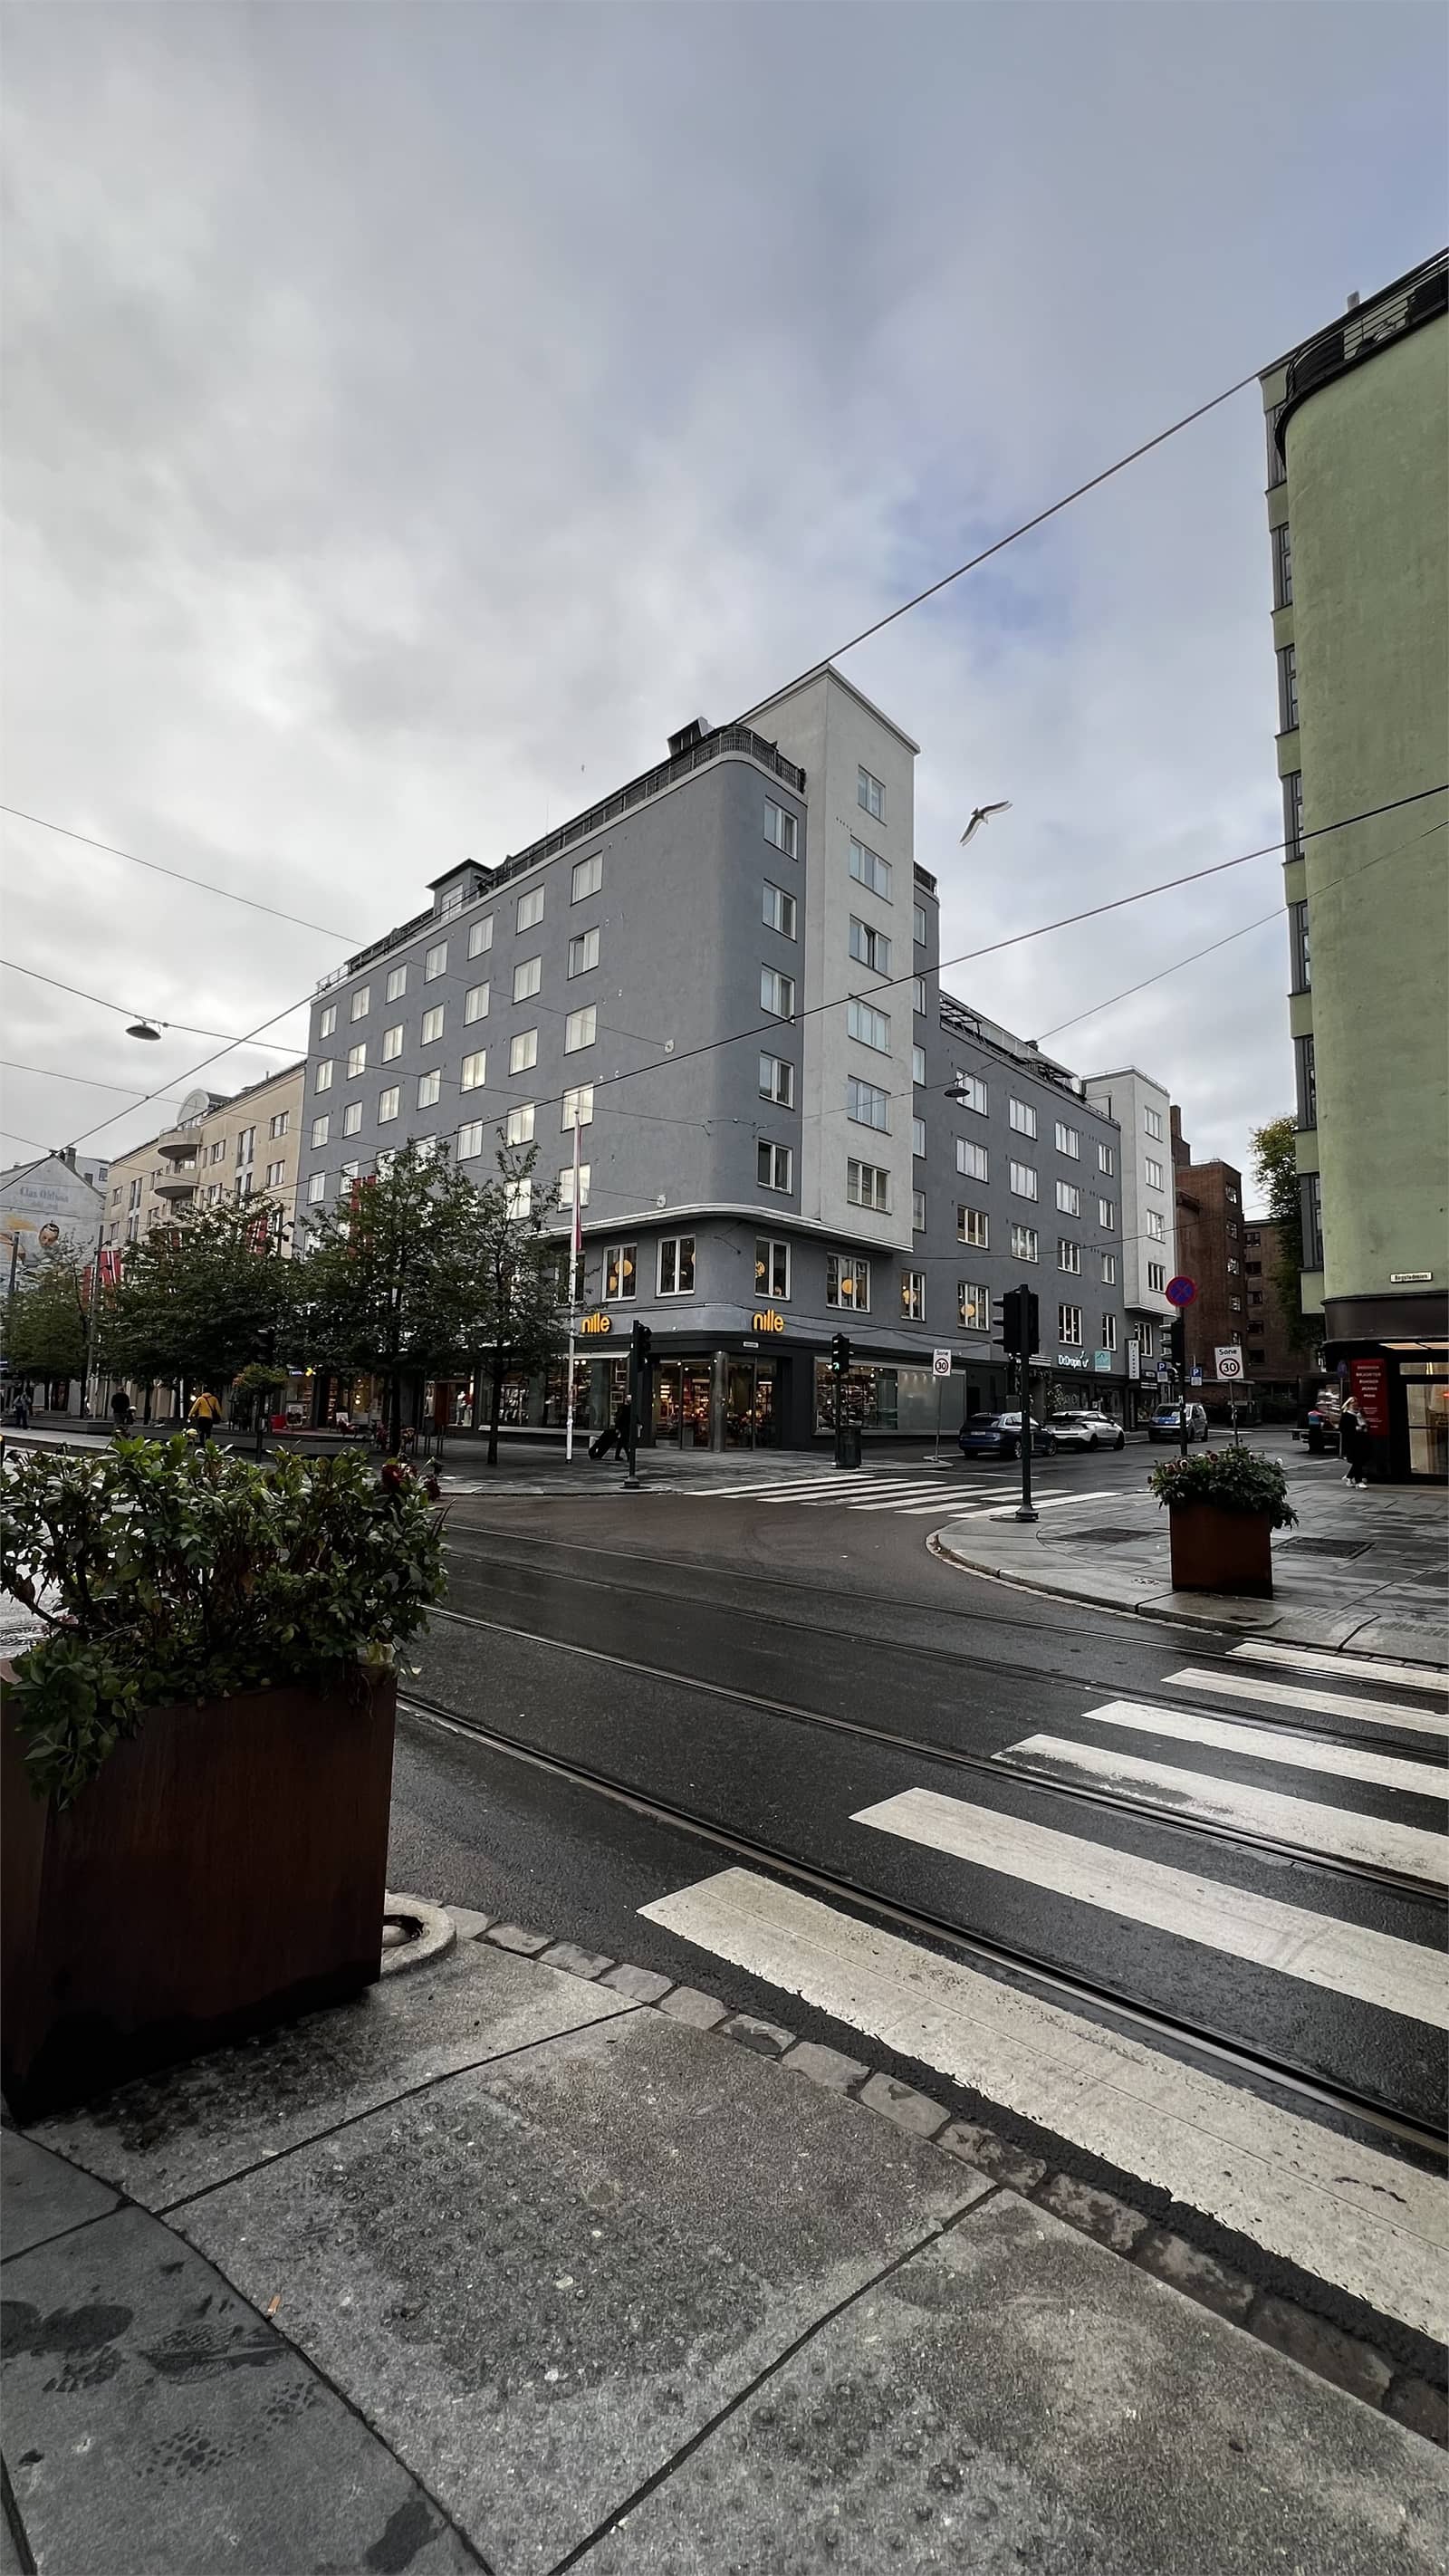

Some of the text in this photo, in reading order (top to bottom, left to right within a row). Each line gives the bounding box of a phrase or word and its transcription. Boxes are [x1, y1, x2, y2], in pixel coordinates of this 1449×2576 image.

[581, 1312, 610, 1333] nille
[753, 1309, 784, 1332] nille
[1158, 1362, 1166, 1371] P
[1223, 1362, 1236, 1372] 30
